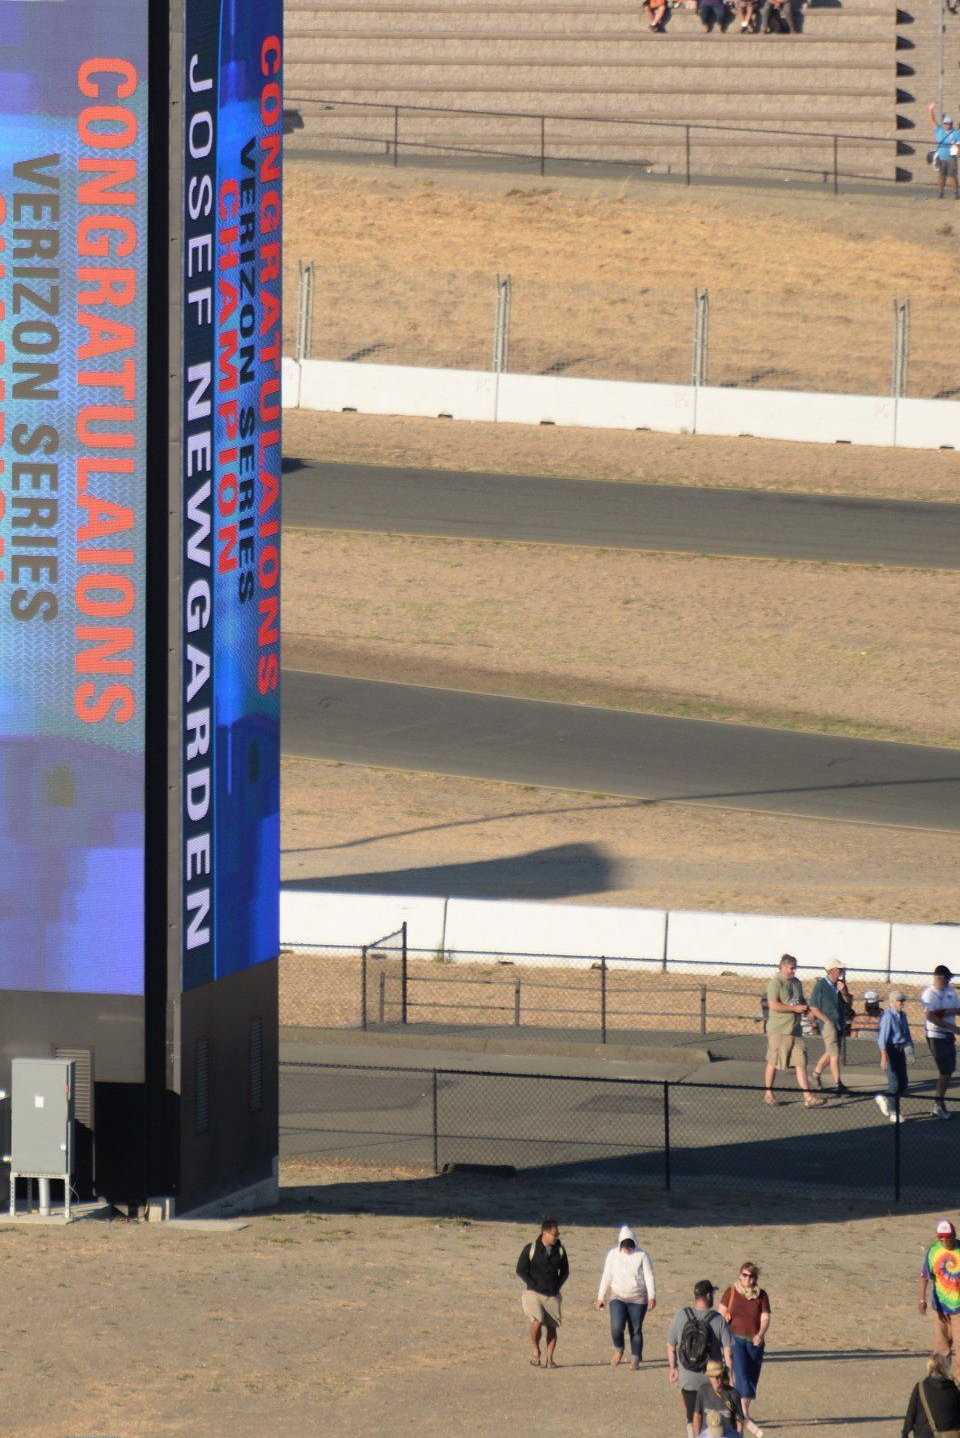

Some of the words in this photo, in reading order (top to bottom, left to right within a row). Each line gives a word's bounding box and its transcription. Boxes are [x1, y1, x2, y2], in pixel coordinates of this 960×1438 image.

[11, 153, 60, 400] VERIZON
[188, 53, 213, 326] JOSEF
[239, 136, 256, 386] VERIZON
[73, 57, 138, 725] CONGRATULAIONS
[217, 178, 239, 575] CHAMPION
[238, 405, 255, 605] SERIES
[9, 423, 59, 623] SERIES
[186, 361, 212, 950] NEWGARDEN
